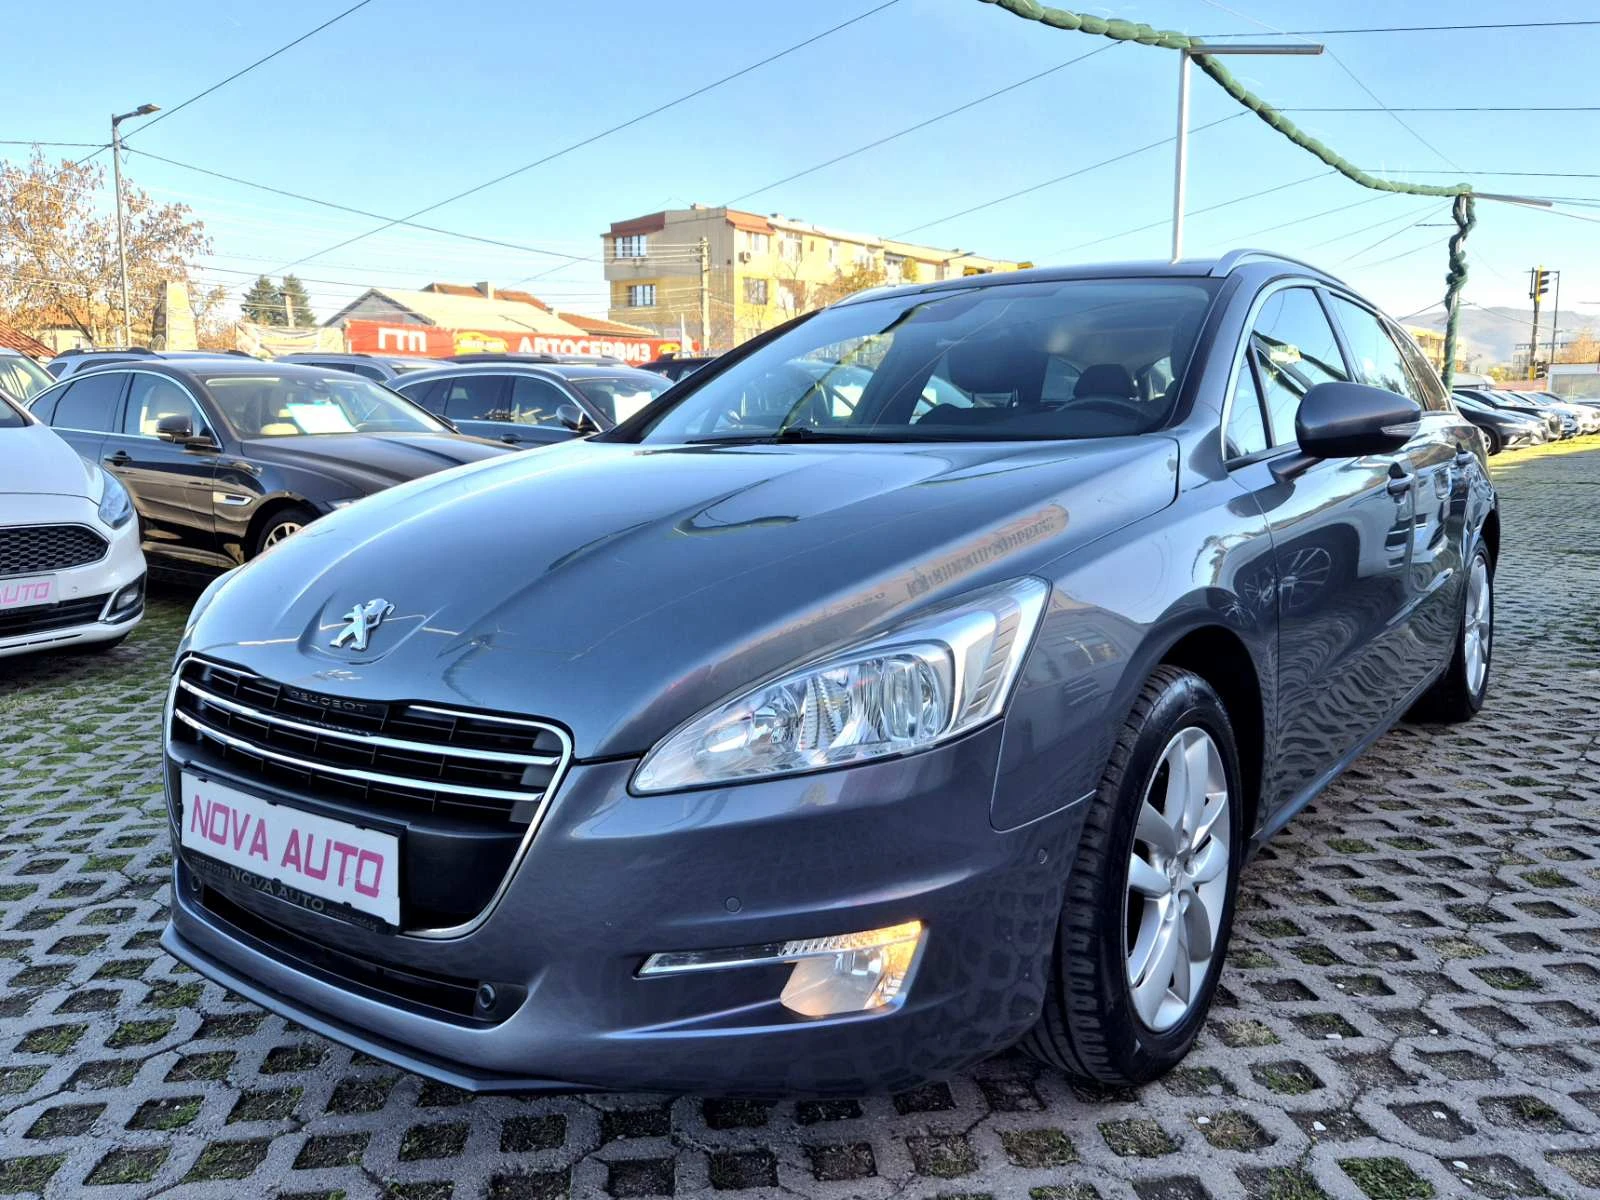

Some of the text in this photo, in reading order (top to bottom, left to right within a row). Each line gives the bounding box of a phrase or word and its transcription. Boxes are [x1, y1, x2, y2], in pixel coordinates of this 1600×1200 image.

[378, 327, 427, 352] ГТП
[518, 336, 650, 362] АВТОСЕРВИЗ
[0, 582, 50, 604] UTO
[190, 794, 384, 899] NOVA AUTO
[228, 866, 325, 913] NOVA AUTO
